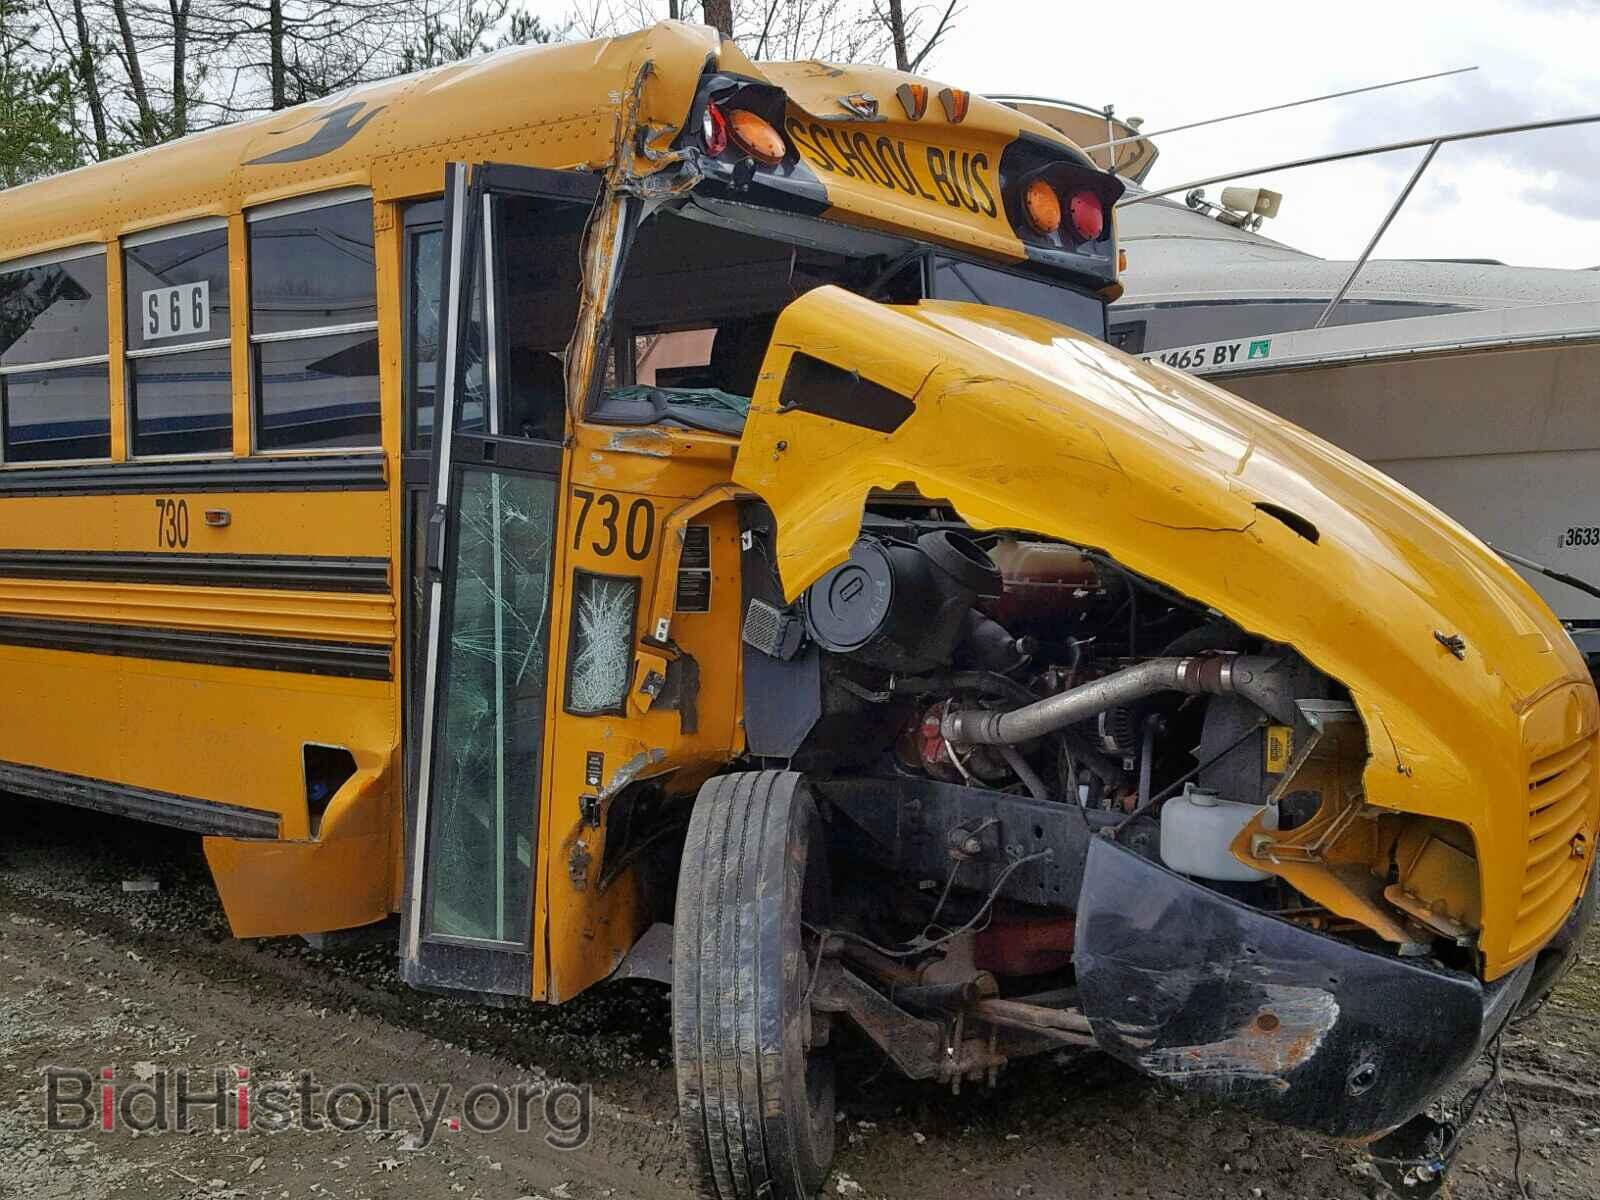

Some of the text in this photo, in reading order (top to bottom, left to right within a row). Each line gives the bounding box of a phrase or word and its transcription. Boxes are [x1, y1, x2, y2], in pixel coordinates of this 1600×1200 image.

[785, 116, 998, 219] SCHOOL BUS
[1212, 343, 1242, 365] BY
[155, 498, 189, 549] 730
[573, 489, 656, 561] 730
